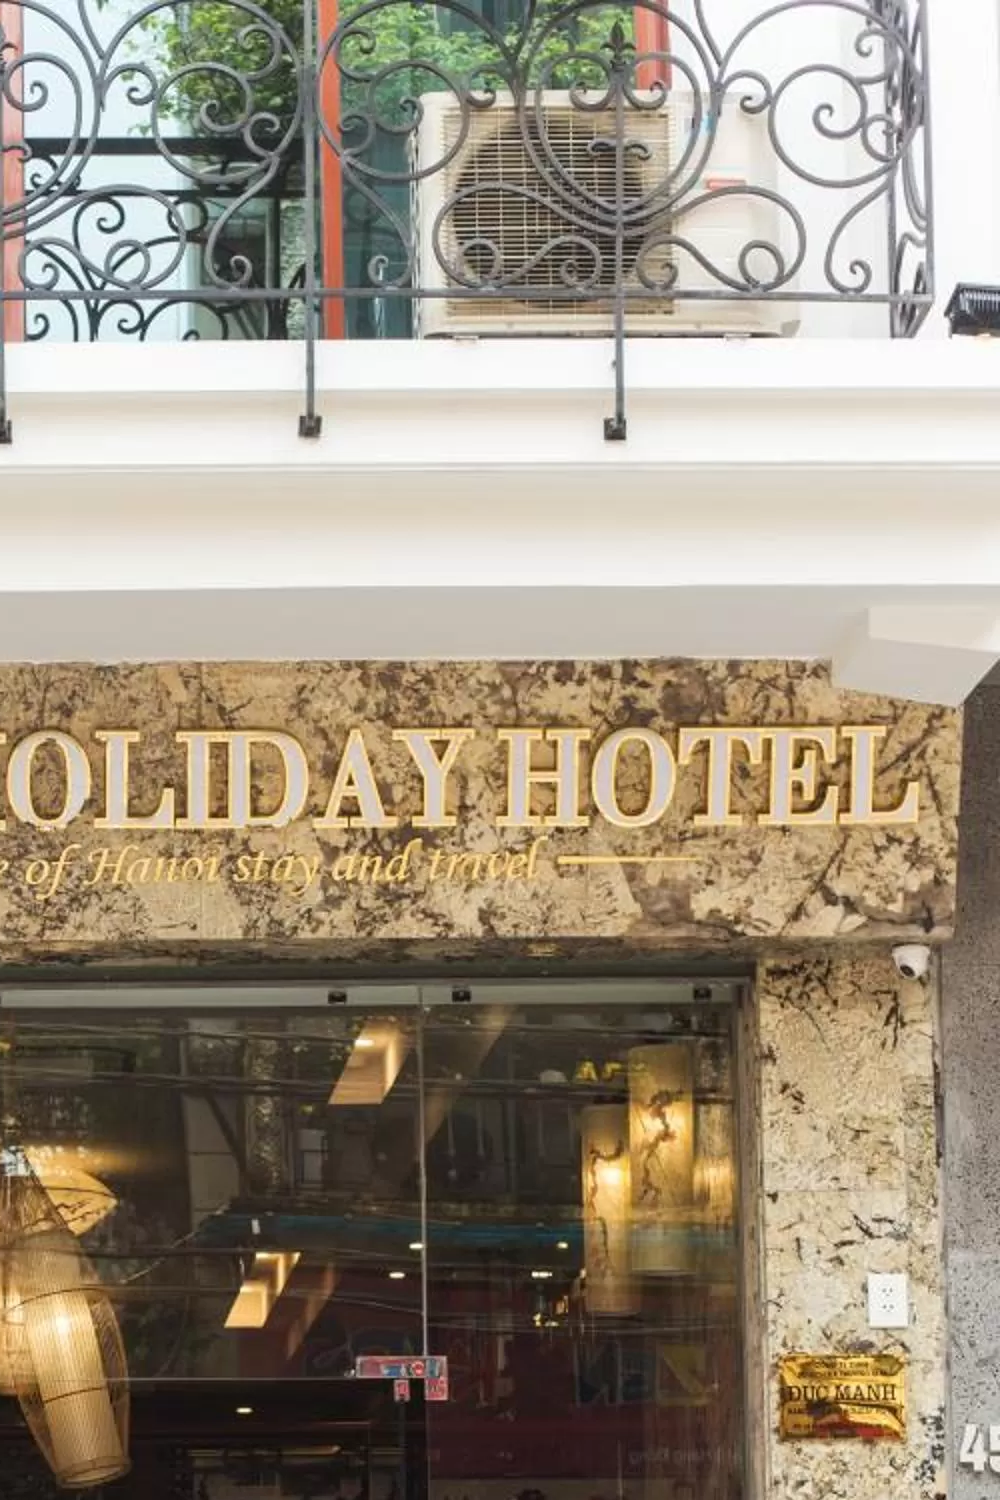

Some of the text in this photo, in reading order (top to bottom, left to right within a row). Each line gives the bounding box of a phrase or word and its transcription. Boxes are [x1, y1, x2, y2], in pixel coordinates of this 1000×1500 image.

[496, 724, 920, 828] HOTEL
[25, 843, 82, 900] of
[84, 844, 222, 885] Hanoi
[233, 850, 320, 896] stay
[332, 838, 422, 882] and
[428, 835, 549, 881] travel
